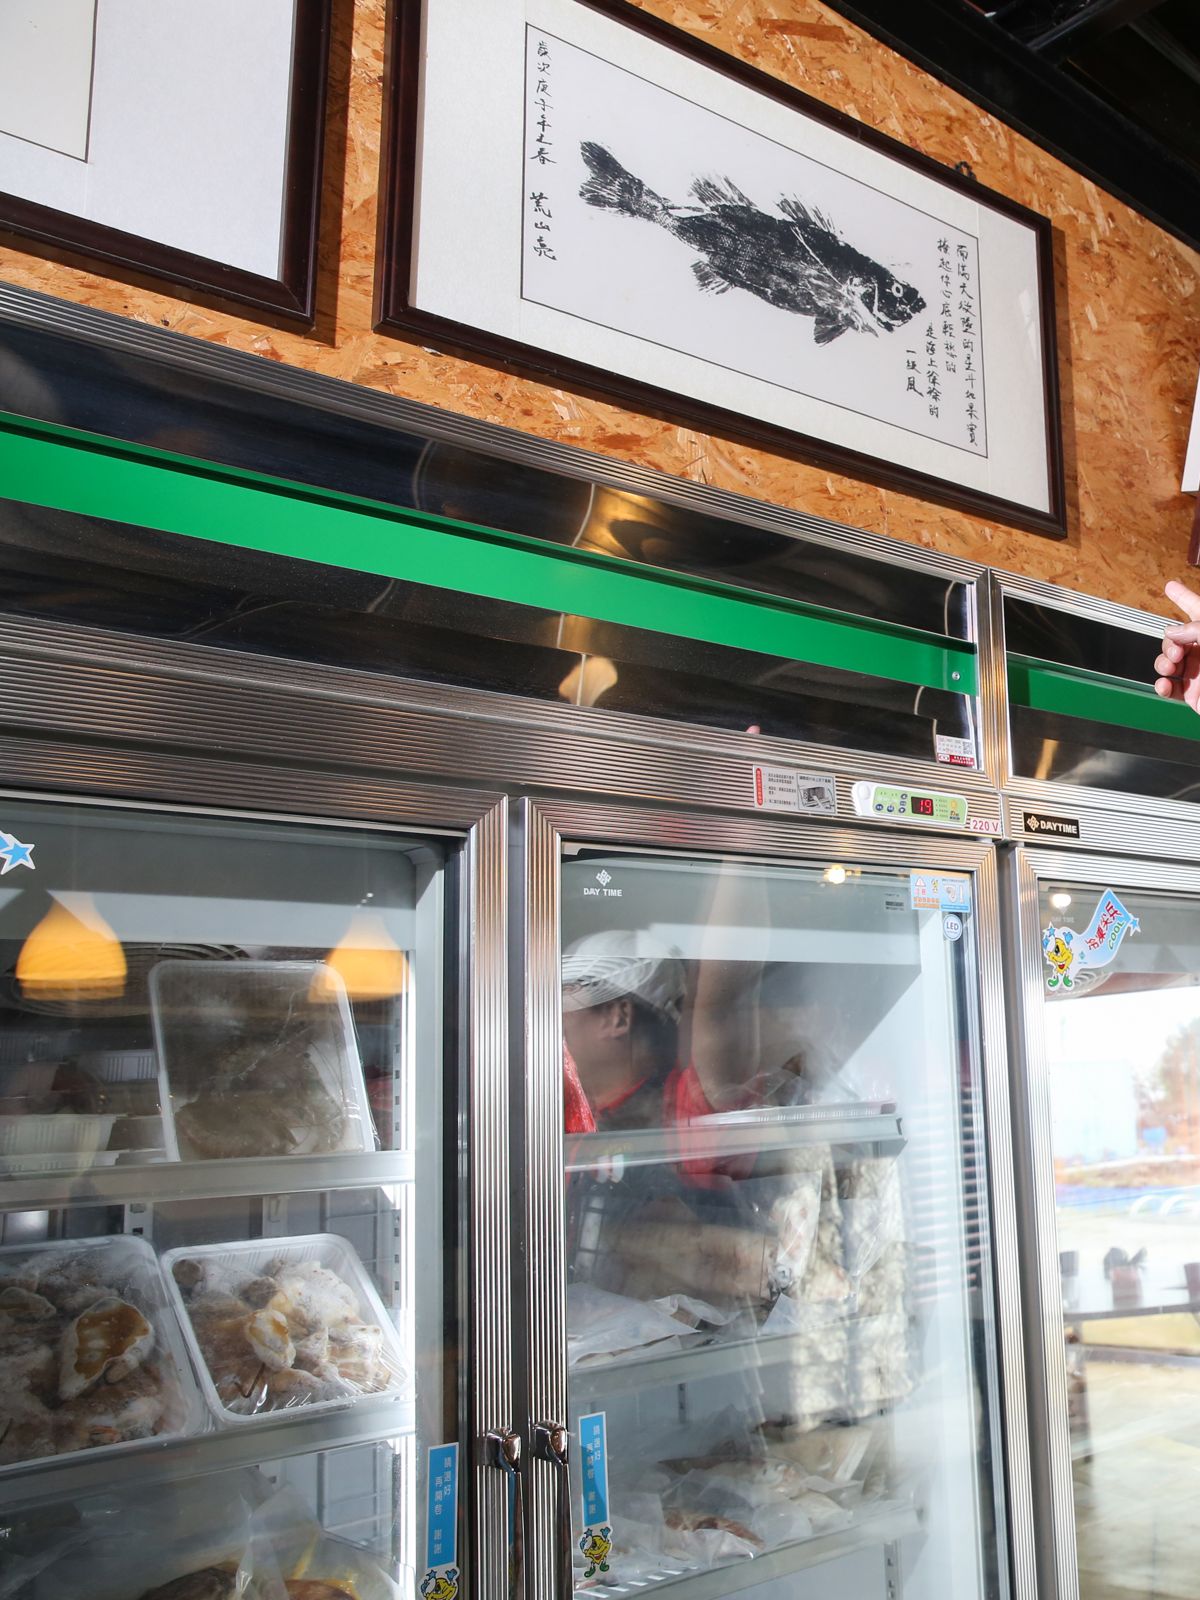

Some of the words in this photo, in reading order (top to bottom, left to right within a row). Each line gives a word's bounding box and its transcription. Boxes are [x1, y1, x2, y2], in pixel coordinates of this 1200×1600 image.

[919, 799, 932, 814] 19
[972, 819, 990, 831] 220
[991, 822, 999, 832] V
[1040, 820, 1078, 834] DAYTIME
[583, 887, 601, 896] DAY
[602, 888, 623, 897] TIME
[946, 921, 959, 931] LED
[1108, 921, 1125, 950] COOL
